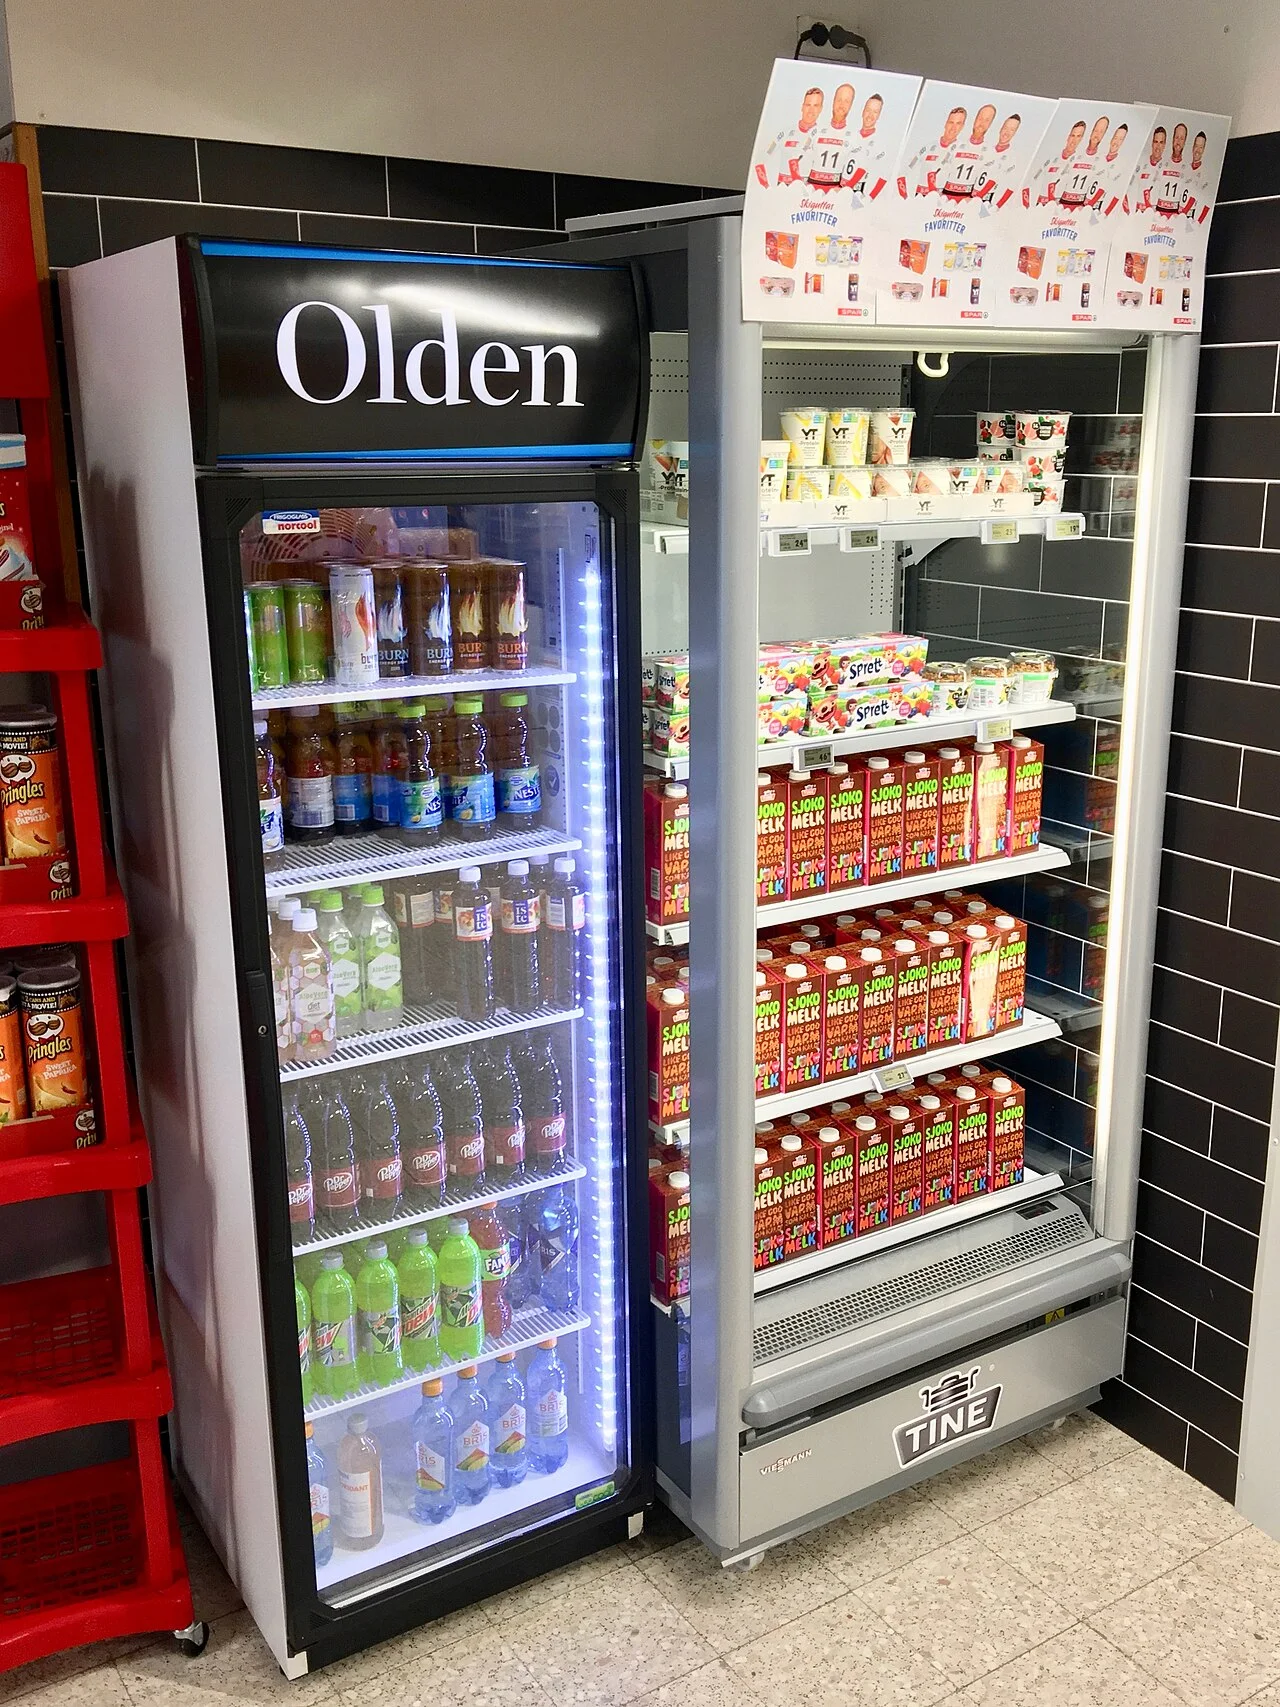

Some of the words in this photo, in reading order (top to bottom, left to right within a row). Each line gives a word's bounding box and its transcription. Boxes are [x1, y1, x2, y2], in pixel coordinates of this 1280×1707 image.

[820, 150, 839, 169] 11
[846, 158, 856, 175] 6
[956, 164, 974, 180] 11
[979, 172, 987, 186] 6
[1072, 175, 1088, 190] 11
[800, 198, 834, 212] Skiguttas
[791, 211, 838, 227] FAVORITTER
[925, 220, 966, 235] FAVORITTER
[1041, 228, 1078, 242] FAVORITTER
[1144, 234, 1177, 248] FAVORITTER
[964, 311, 982, 319] SPAR
[277, 301, 585, 407] Olden
[802, 429, 818, 440] YT
[833, 428, 849, 439] YT
[892, 428, 907, 439] YT
[953, 481, 969, 491] YT
[835, 506, 848, 516] YT
[919, 501, 932, 511] YT
[993, 499, 1004, 508] YT
[277, 520, 317, 531] norcool
[379, 649, 409, 661] BURN
[849, 657, 883, 680] Sprett
[856, 698, 890, 722] Sprett
[3, 742, 28, 750] MOVIE!
[1016, 762, 1041, 777] SJOKO
[907, 779, 937, 794] SJOKO
[943, 773, 973, 788] SJOKO
[1015, 775, 1041, 792] MELK
[1, 782, 44, 806] Pringles
[831, 790, 862, 806] SJOKO
[871, 785, 901, 801] SJOKO
[906, 793, 937, 810] MELK
[942, 787, 973, 803] MELK
[17, 808, 44, 818] SWEET
[758, 802, 785, 819] JOKO
[792, 796, 824, 813] SJOKO
[830, 804, 862, 822] MELK
[871, 798, 901, 816] MELK
[15, 813, 50, 827] PAPRIKA
[792, 810, 824, 829] MELK
[1013, 831, 1038, 848] MELK
[905, 852, 935, 868] MELK
[941, 845, 971, 861] MELK
[831, 865, 862, 883] MELK
[870, 858, 900, 876] MELK
[792, 872, 824, 890] MELK
[1000, 941, 1025, 958] SJOKO
[931, 957, 961, 973] SJOKO
[999, 953, 1024, 971] MELK
[898, 966, 928, 983] SJOKO
[930, 970, 961, 987] MELK
[827, 984, 859, 1001] SJOKO
[864, 975, 894, 993] SJOKO
[898, 978, 927, 997] MELK
[787, 992, 820, 1010] SJOKO
[863, 988, 893, 1007] MELK
[787, 1006, 819, 1025] MELK
[827, 998, 858, 1016] MELK
[997, 1007, 1022, 1025] MELK
[929, 1026, 959, 1042] MELK
[28, 1037, 72, 1065] Pringles
[663, 1037, 690, 1056] MEL
[896, 1035, 925, 1052] MELK
[862, 1045, 892, 1063] MELK
[43, 1065, 77, 1080] PAPRIKA
[46, 1060, 73, 1072] SWEET
[825, 1055, 857, 1074] MELK
[787, 1064, 819, 1084] MELK
[663, 1098, 690, 1117] MEL
[995, 1105, 1023, 1122] SJOKO
[926, 1120, 952, 1138] SJOKO
[959, 1112, 987, 1129] SJOKO
[995, 1117, 1023, 1136] MELK
[894, 1132, 921, 1150] SJOKO
[925, 1133, 952, 1152] MELK
[959, 1125, 986, 1143] MELK
[860, 1142, 888, 1161] SJOKO
[894, 1144, 921, 1164] MELK
[415, 1155, 440, 1170] Pepper
[823, 1154, 853, 1174] SJOKO
[859, 1155, 888, 1175] MELK
[380, 1165, 402, 1182] Pepper
[784, 1164, 814, 1183] SJOKO
[823, 1166, 853, 1188] MELK
[995, 1169, 1022, 1187] MELK
[327, 1176, 351, 1192] Pepper
[784, 1176, 815, 1198] MELK
[958, 1177, 986, 1195] MELK
[925, 1186, 951, 1205] MELK
[893, 1198, 920, 1217] MELK
[859, 1209, 887, 1229] MELK
[824, 1221, 853, 1242] MELK
[785, 1232, 815, 1253] MELK
[755, 1246, 783, 1268] MELK
[906, 1396, 988, 1453] TINE
[760, 1449, 812, 1476] VIESSMANN
